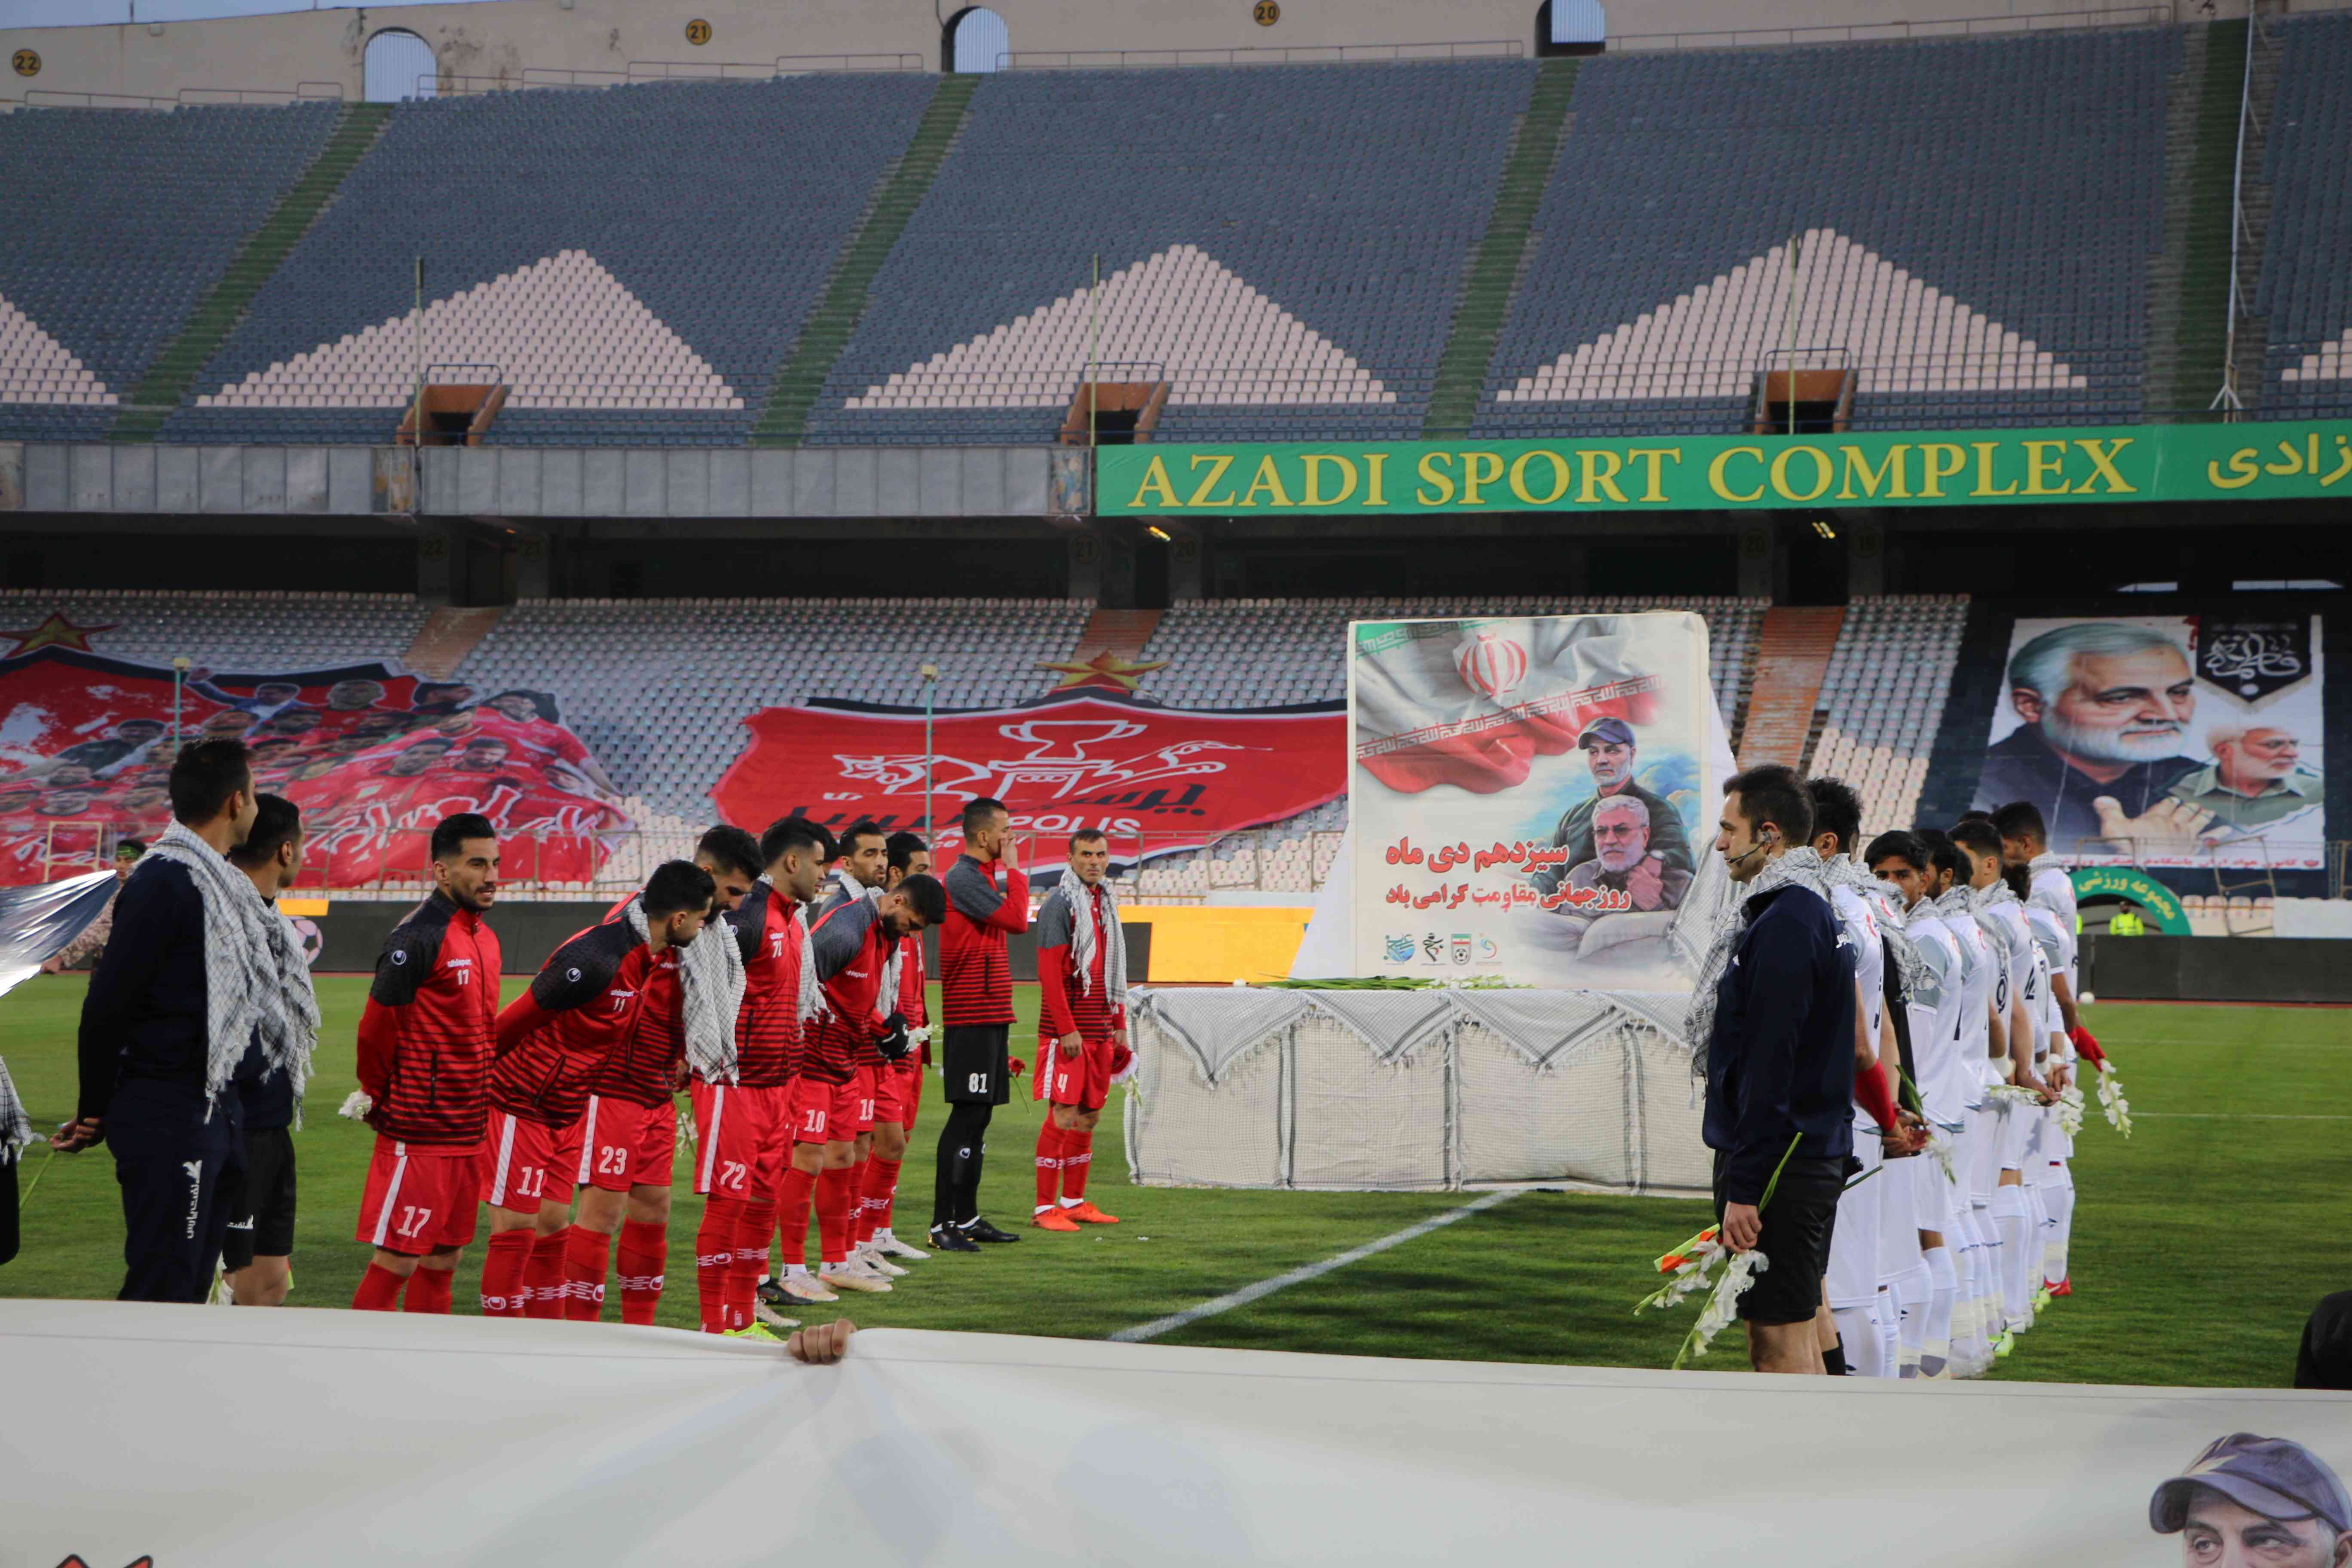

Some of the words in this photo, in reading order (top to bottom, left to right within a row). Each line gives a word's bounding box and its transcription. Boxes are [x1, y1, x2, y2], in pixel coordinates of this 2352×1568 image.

[1258, 6, 1276, 19] 20
[690, 25, 707, 39] 21
[15, 55, 37, 70] 22
[1127, 453, 1389, 507] AZADI
[1417, 447, 1681, 505] SPORT
[1708, 437, 2137, 502] COMPLEX
[1386, 836, 1424, 865] ماه
[1428, 842, 1470, 873] دی
[1474, 841, 1567, 873] سیزدهم
[2078, 871, 2128, 892] ورزشی
[1385, 884, 1410, 909] باد
[1471, 884, 1537, 914] مقاومت
[1540, 882, 1597, 910] جهانی
[1596, 885, 1631, 910] روز
[2131, 879, 2175, 920] مجموعه
[457, 969, 469, 985] 17
[845, 970, 868, 979] uhlsport
[968, 1072, 988, 1093] 81
[1057, 1073, 1069, 1093] 4
[804, 1109, 826, 1133] 10
[859, 1098, 875, 1121] 19
[598, 1145, 628, 1176] 23
[517, 1166, 545, 1198] 11
[720, 1160, 747, 1190] 72
[397, 1205, 432, 1238] 17
